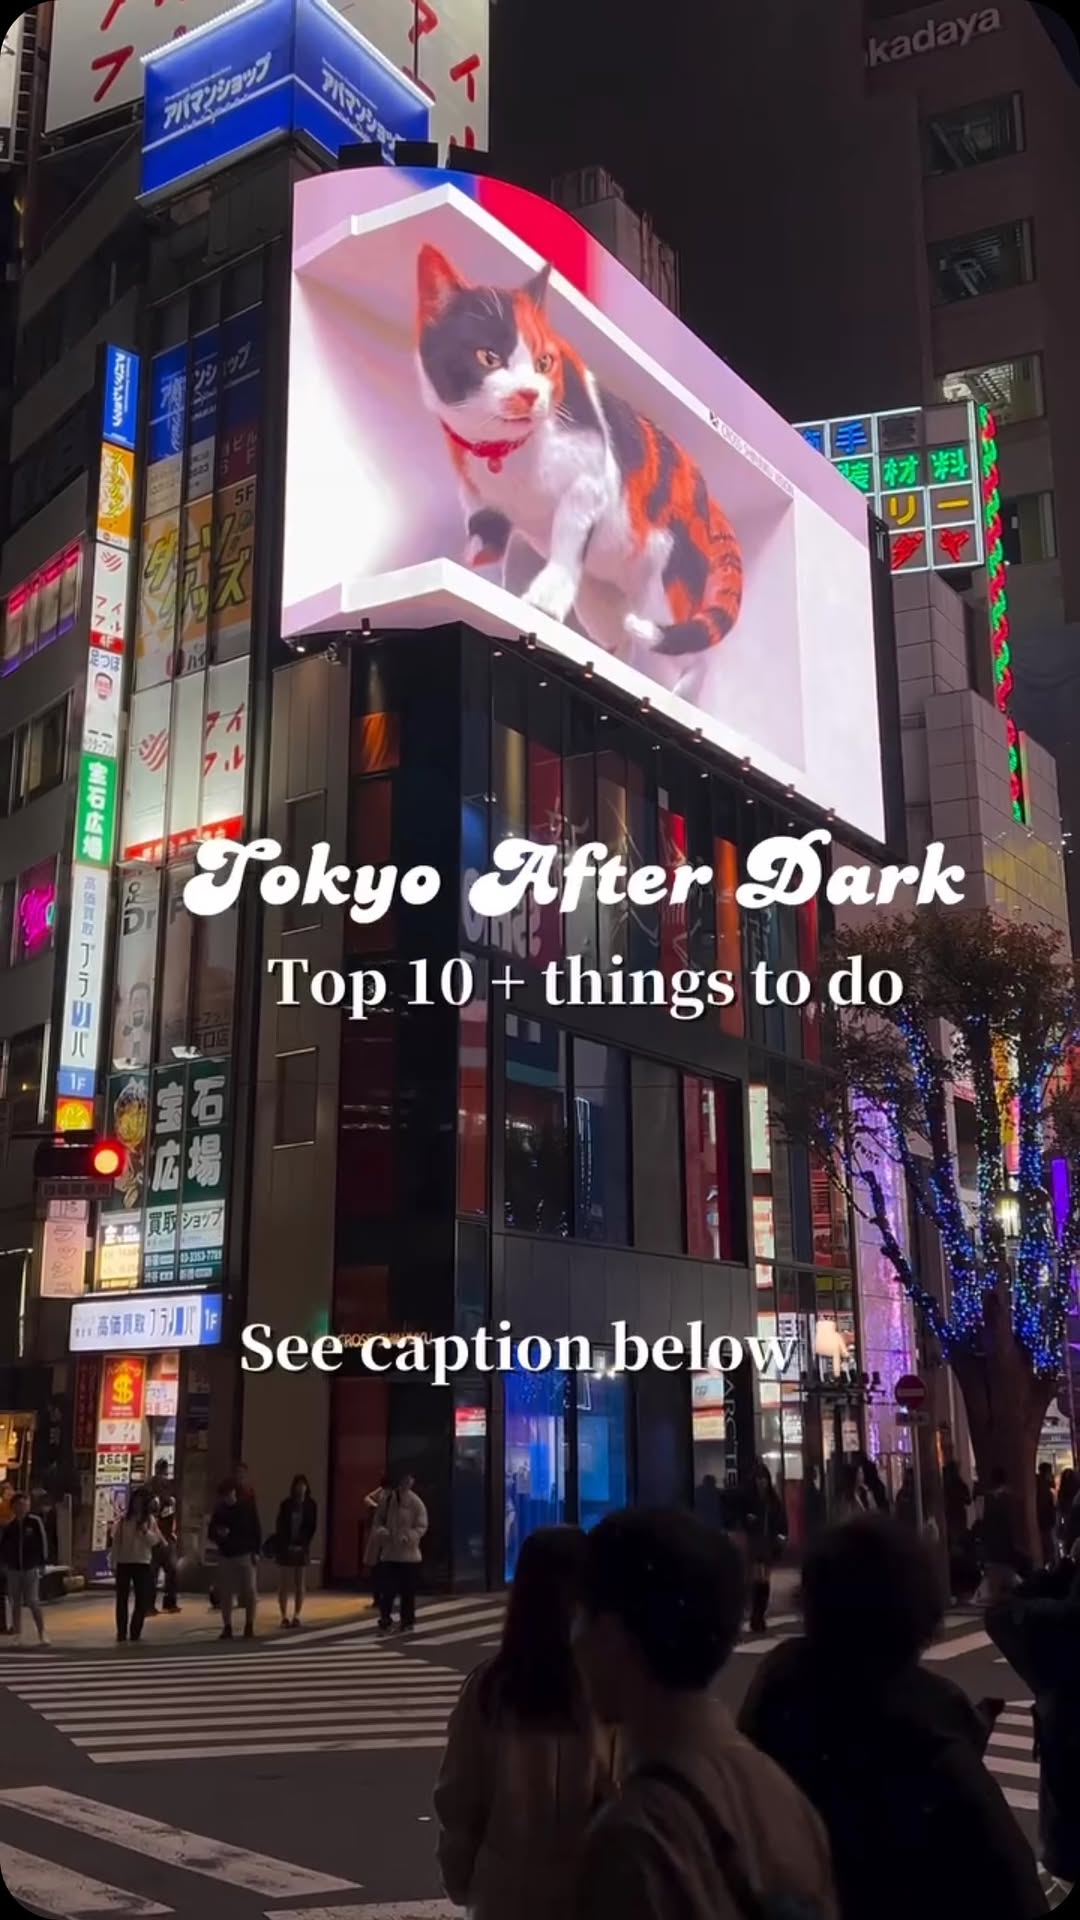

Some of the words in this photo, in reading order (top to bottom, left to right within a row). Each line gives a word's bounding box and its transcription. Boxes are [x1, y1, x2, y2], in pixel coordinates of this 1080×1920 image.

[866, 8, 1000, 67] kadaya
[163, 50, 272, 130] アパマンショップ
[69, 1072, 87, 1092] 1F
[205, 1308, 217, 1331] 1F
